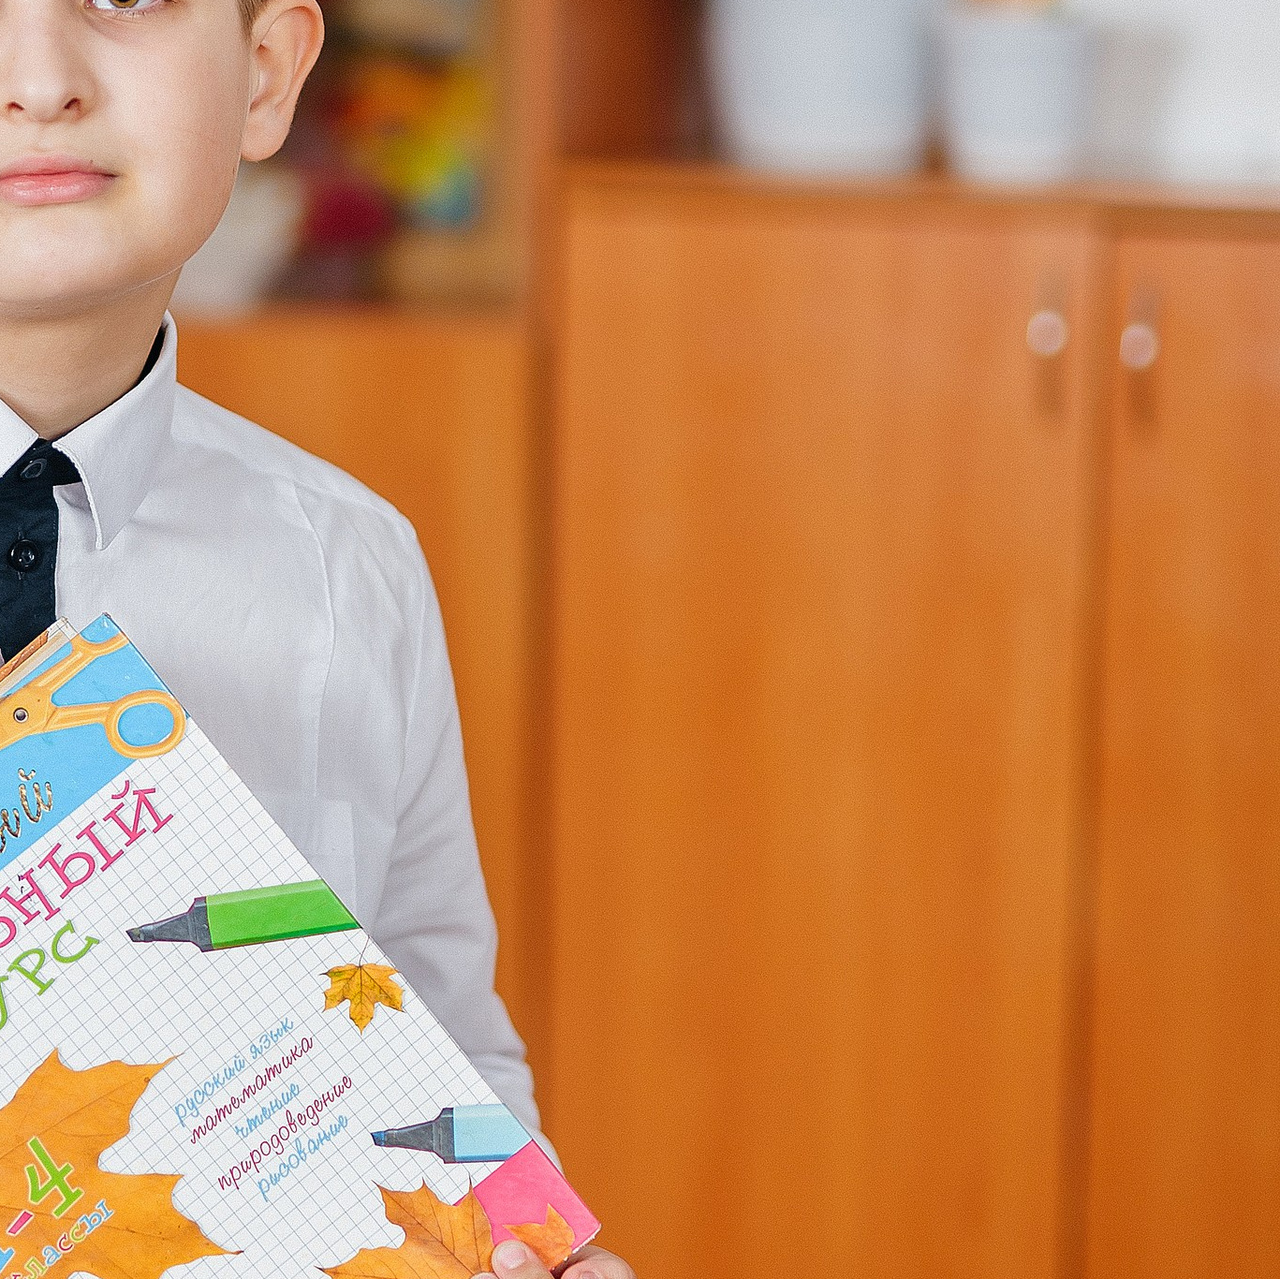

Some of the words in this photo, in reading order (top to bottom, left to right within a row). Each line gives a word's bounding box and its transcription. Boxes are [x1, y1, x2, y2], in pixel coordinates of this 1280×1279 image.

[175, 1055, 245, 1127] русский
[250, 1018, 293, 1059] язык
[191, 1037, 313, 1144] математика
[235, 1083, 300, 1137] чтение
[218, 1076, 352, 1190] природоведение
[258, 1115, 347, 1202] рисование
